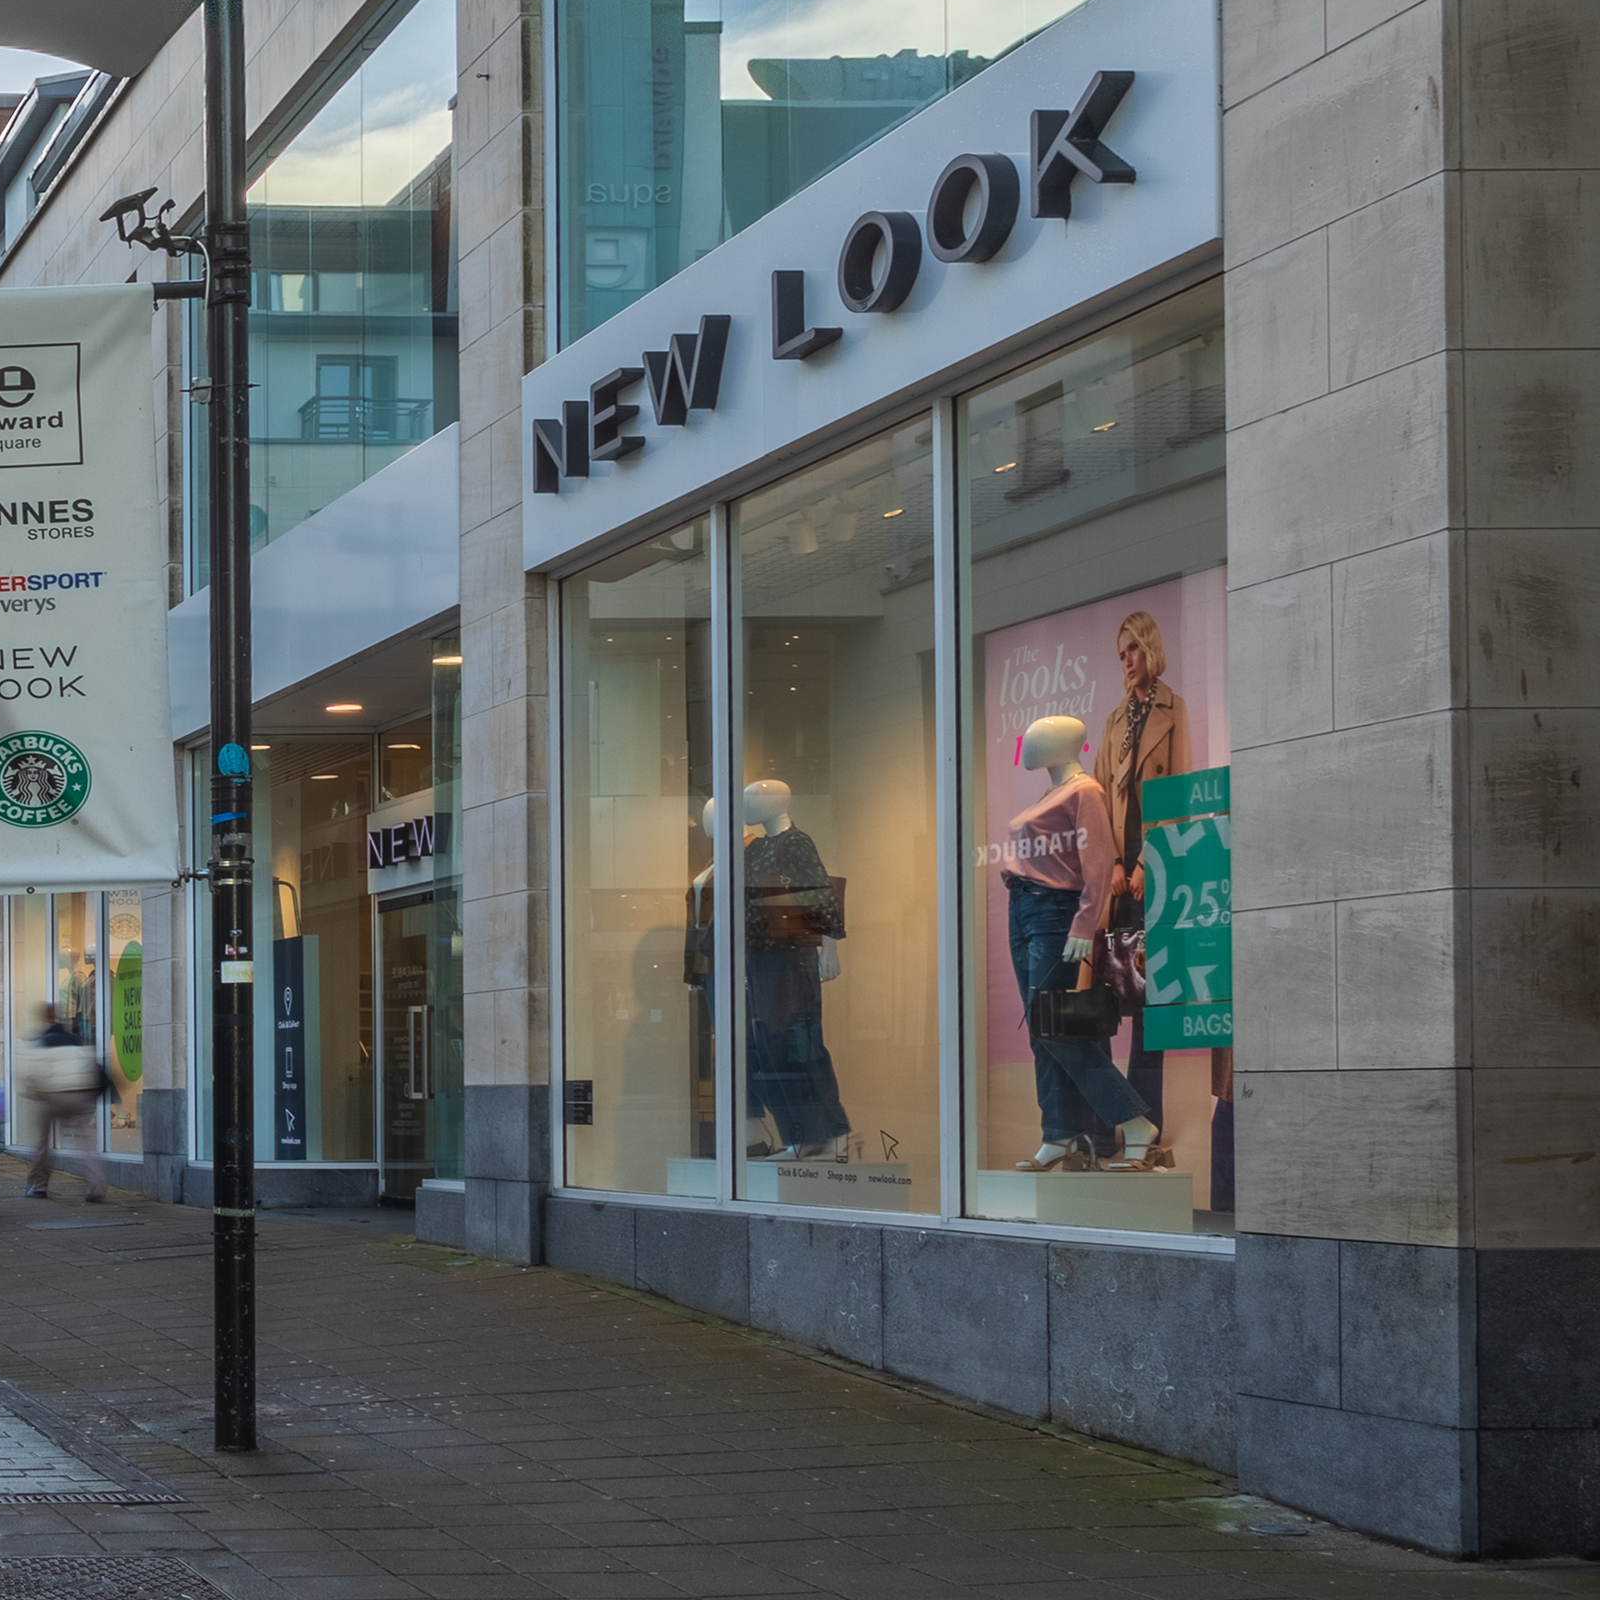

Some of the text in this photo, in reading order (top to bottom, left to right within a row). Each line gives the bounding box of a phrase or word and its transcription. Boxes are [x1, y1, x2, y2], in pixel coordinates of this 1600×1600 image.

[533, 70, 1136, 494] NEW LOOK
[27, 526, 94, 540] STORES
[1014, 645, 1039, 666] The
[999, 643, 1088, 708] looks
[997, 681, 1097, 742] you need
[1189, 779, 1222, 804] ALL
[367, 816, 435, 867] NEW
[124, 988, 142, 1007] NEW
[124, 1012, 142, 1030] SALE
[1183, 1014, 1232, 1037] BAGS
[122, 1035, 142, 1054] NOW
[777, 1167, 819, 1179] Click & Collect
[827, 1170, 857, 1183] Shop app
[868, 1174, 912, 1186] newlook.com
